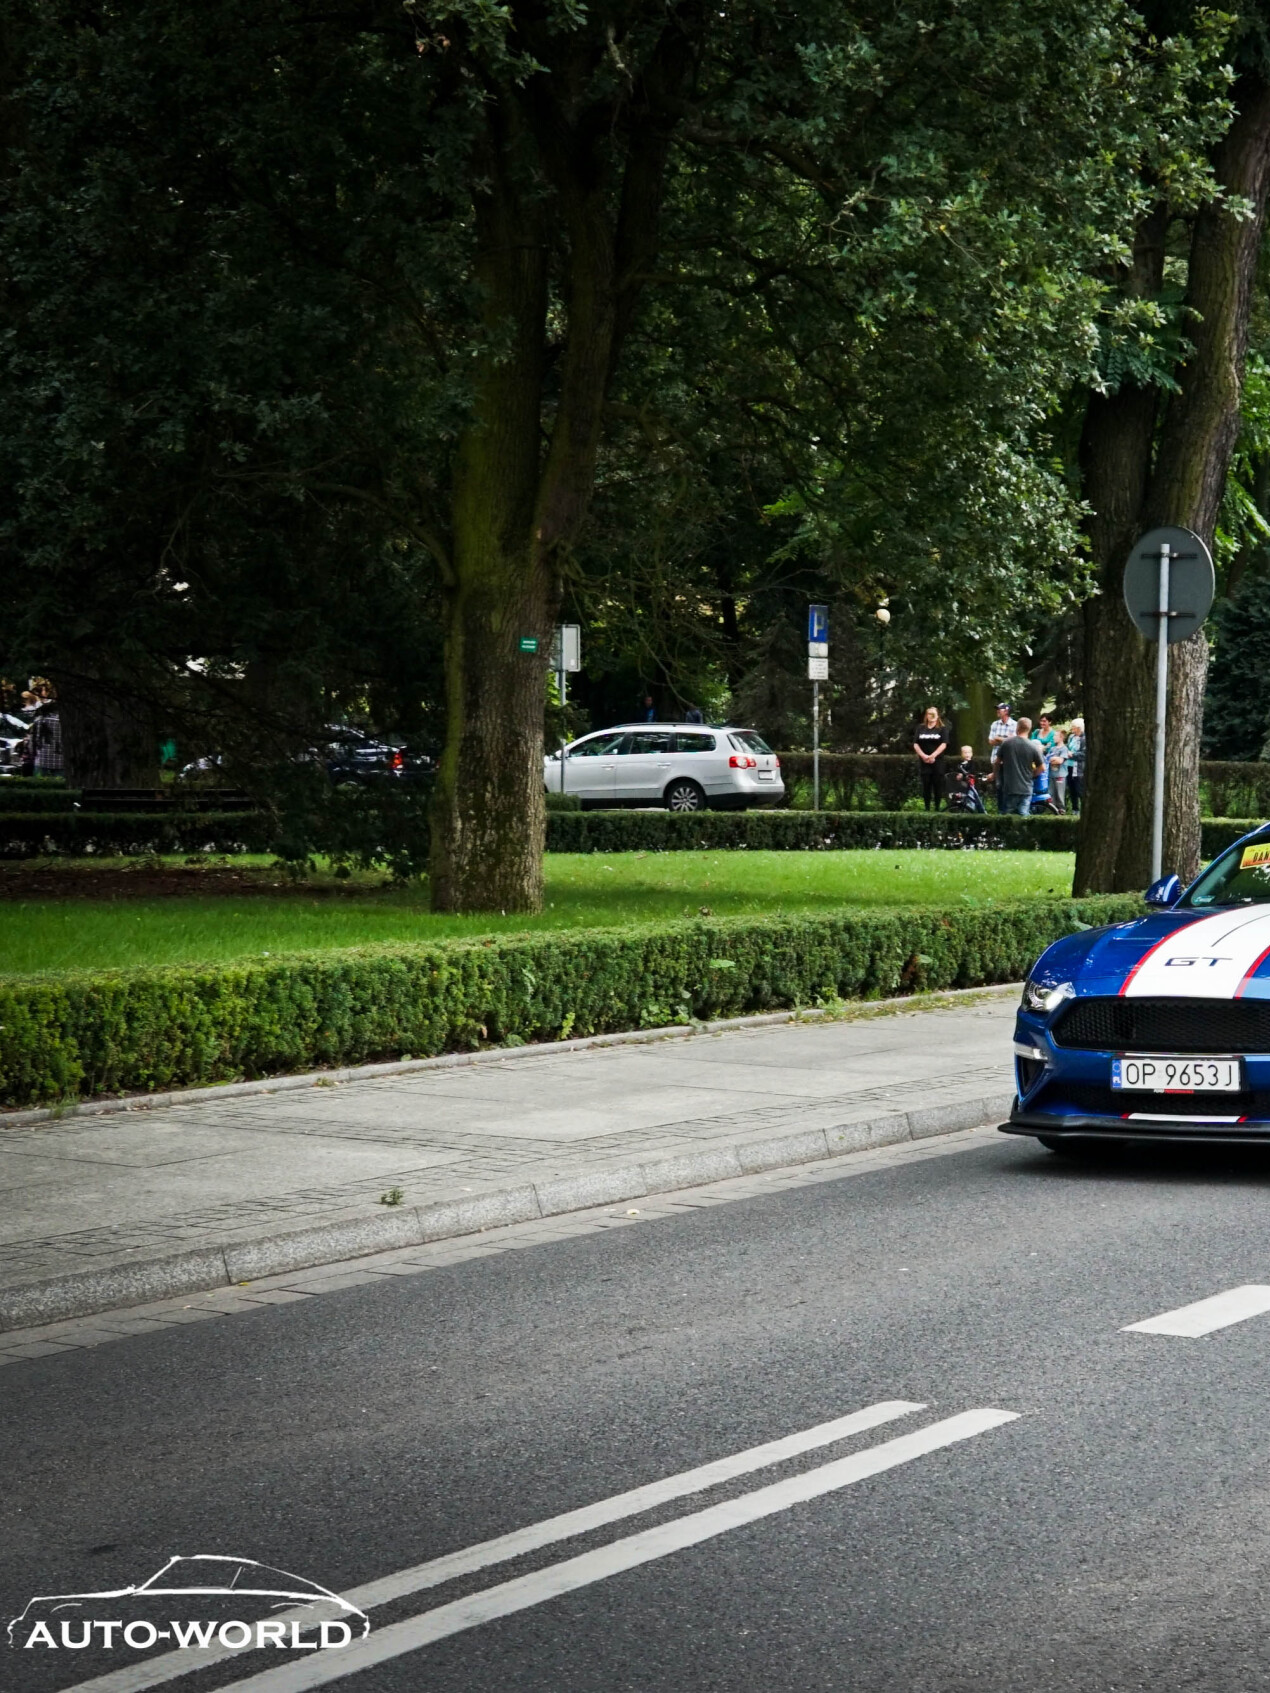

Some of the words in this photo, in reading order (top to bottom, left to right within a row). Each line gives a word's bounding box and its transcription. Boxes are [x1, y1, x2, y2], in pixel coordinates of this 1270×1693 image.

[1164, 957, 1233, 967] GT
[1126, 1063, 1156, 1085] OP
[1165, 1063, 1232, 1087] 9653J
